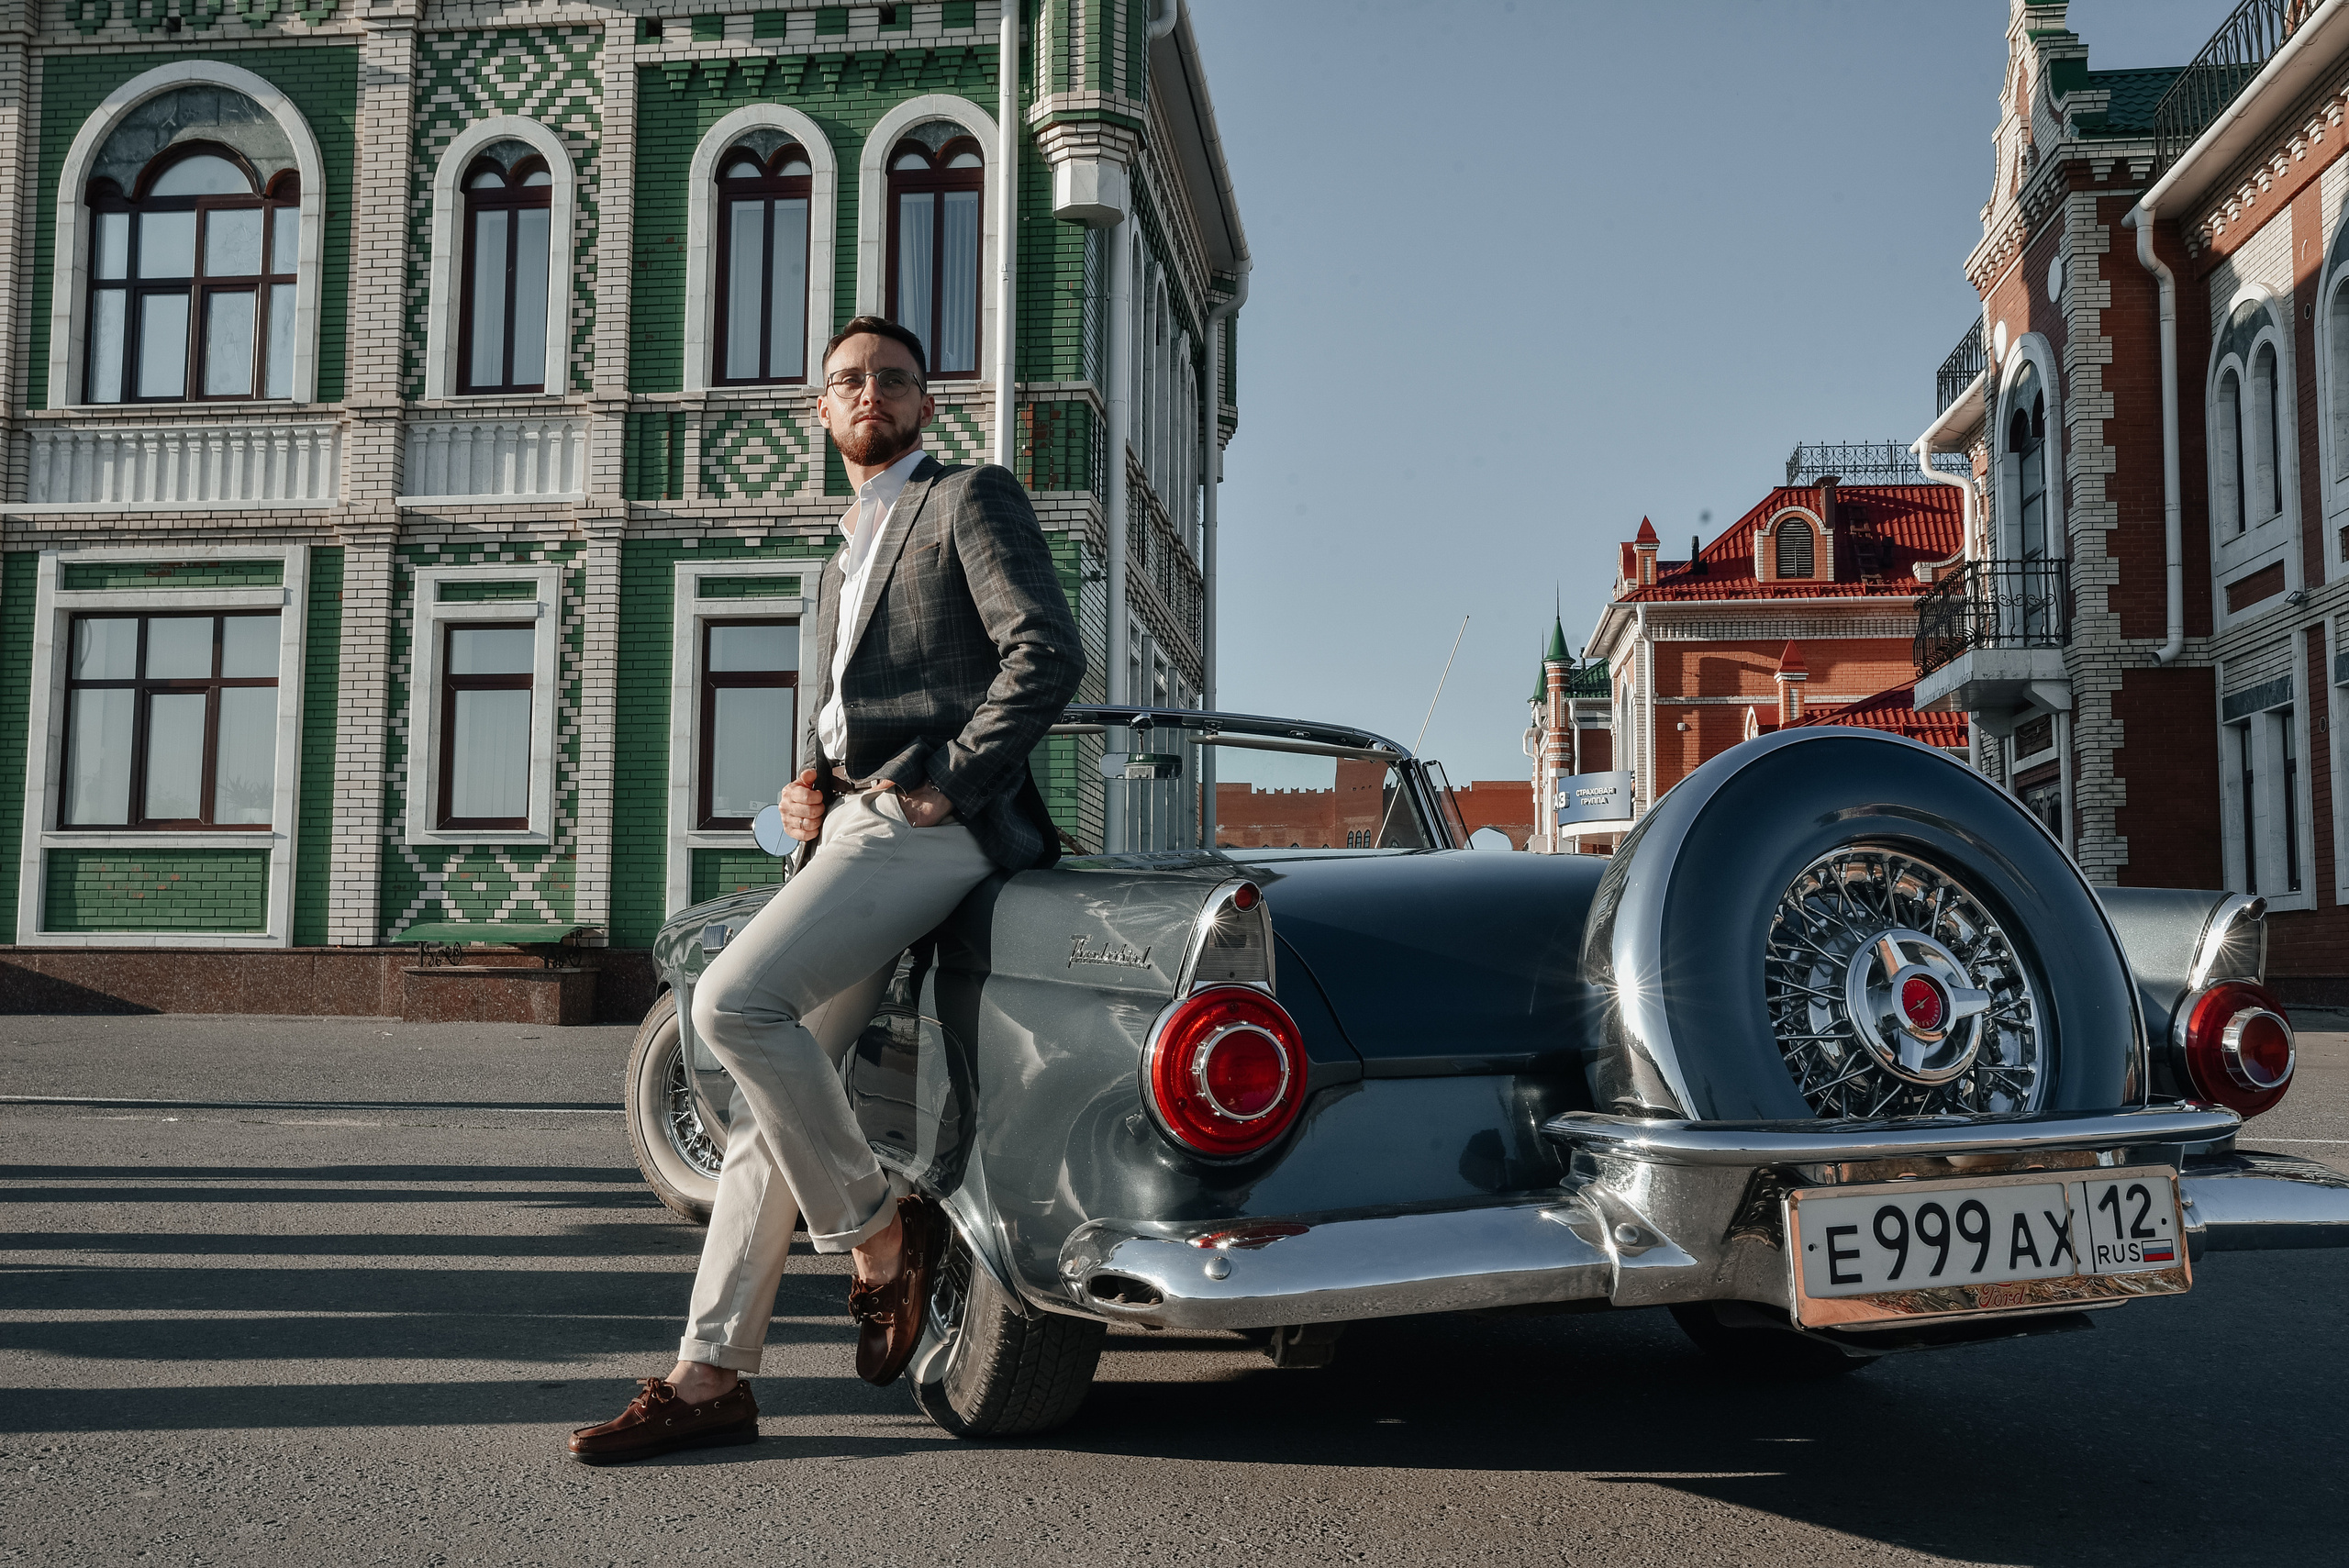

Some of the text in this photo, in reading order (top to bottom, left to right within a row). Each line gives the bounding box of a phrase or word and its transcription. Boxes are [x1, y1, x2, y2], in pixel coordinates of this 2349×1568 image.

[1576, 787, 1614, 796] СТРАХОВАЯ
[1581, 797, 1608, 806] ГРУППА
[2098, 1184, 2155, 1240] 12
[2098, 1241, 2141, 1265] RUS
[1978, 1283, 2026, 1308] Ford
